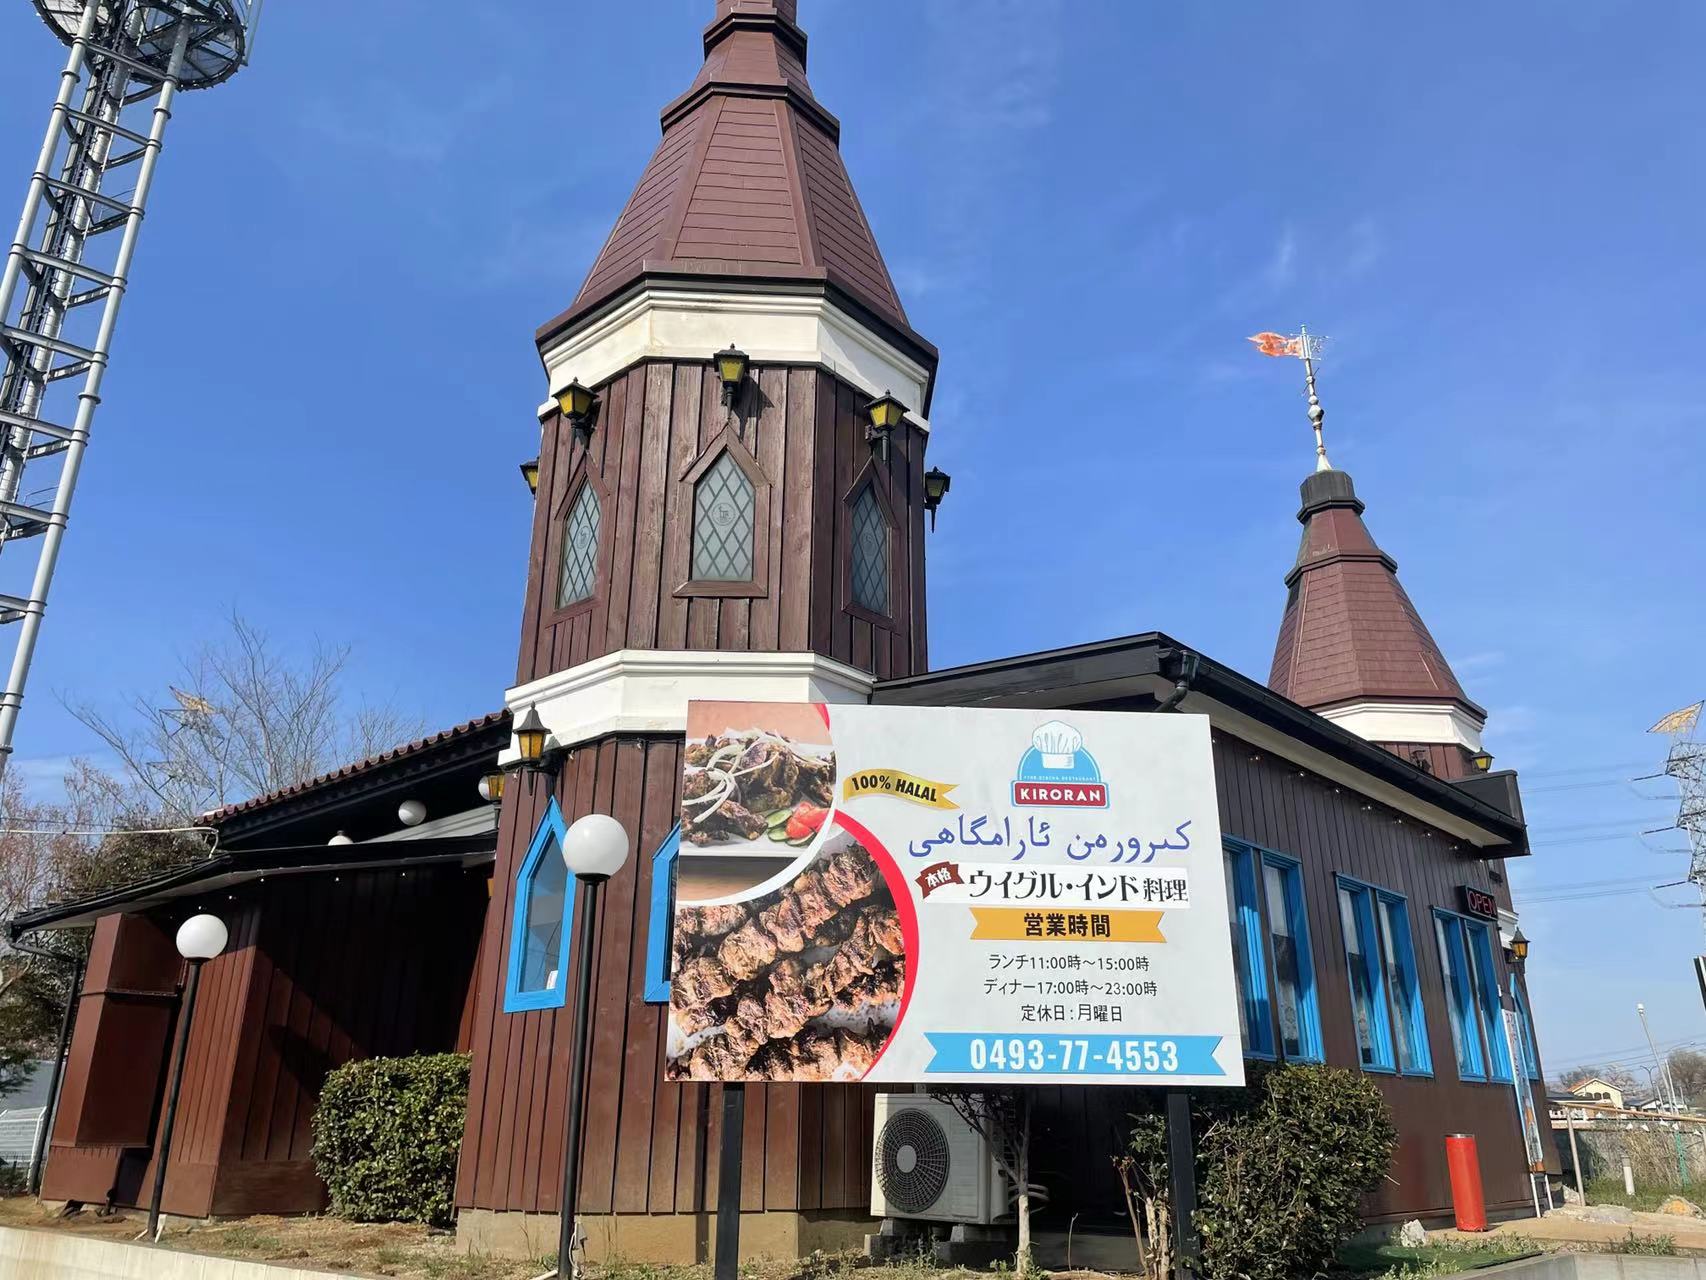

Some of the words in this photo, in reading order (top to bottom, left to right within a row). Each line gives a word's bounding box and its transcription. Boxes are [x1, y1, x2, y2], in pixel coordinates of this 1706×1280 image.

[852, 775, 891, 791] 100%
[895, 778, 937, 802] HALAL
[1020, 788, 1100, 801] KIRORAN
[925, 867, 952, 887] 本格
[1468, 890, 1497, 916] OPEN
[1023, 912, 1111, 938] 営業時間
[970, 1038, 1179, 1072] 0493-77-4553
